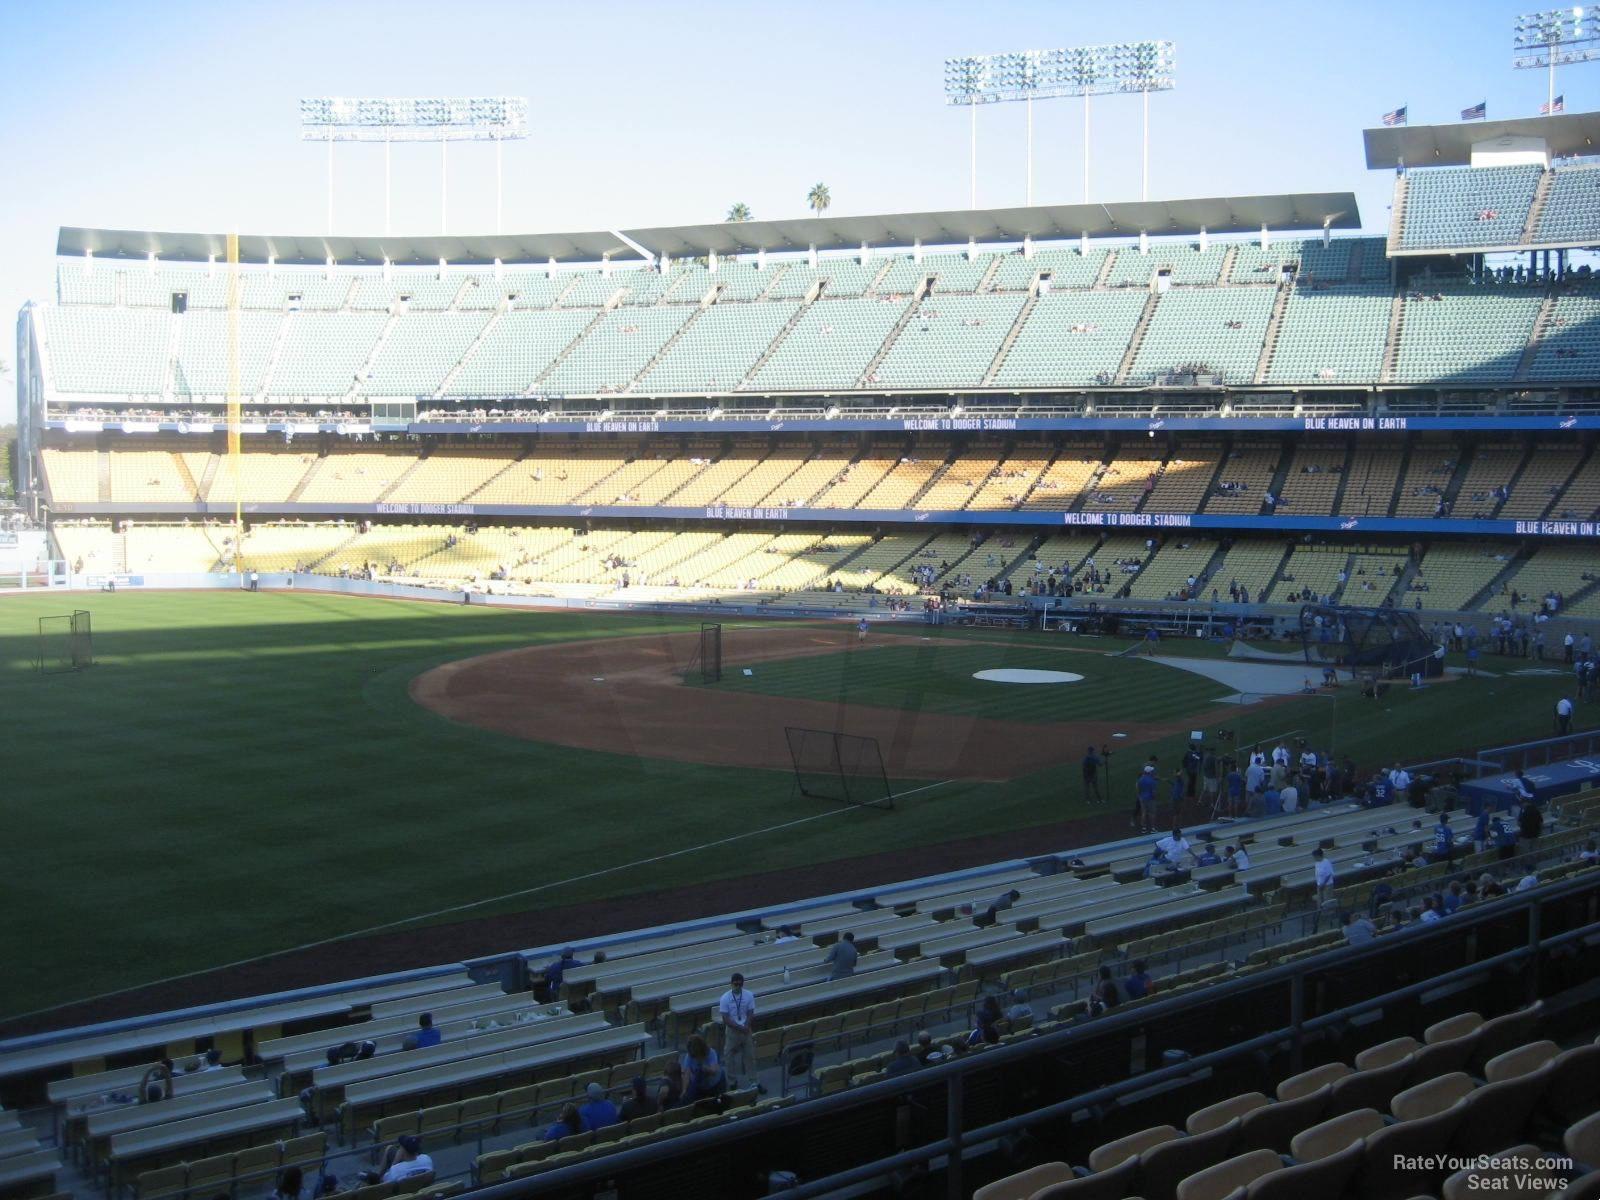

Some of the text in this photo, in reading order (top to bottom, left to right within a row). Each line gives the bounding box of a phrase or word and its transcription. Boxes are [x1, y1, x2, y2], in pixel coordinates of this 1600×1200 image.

[224, 395, 310, 403] SADIUM
[586, 421, 659, 432] BLUE HEAVEN ON EARTH
[903, 418, 1016, 430] WELCOME TO DODGER STADIUM
[1304, 417, 1407, 430] BLUE HEAVEN ON EARTH
[376, 503, 475, 515] WELCOME TO DODGER STADIUM
[706, 507, 788, 519] BLUE HEAVEN ON EARTH
[1064, 512, 1191, 527] WELCOME TO DODGER STADIUM
[1516, 521, 1538, 534] BLUE
[1541, 521, 1577, 535] HEAVEN
[1580, 522, 1593, 535] ON
